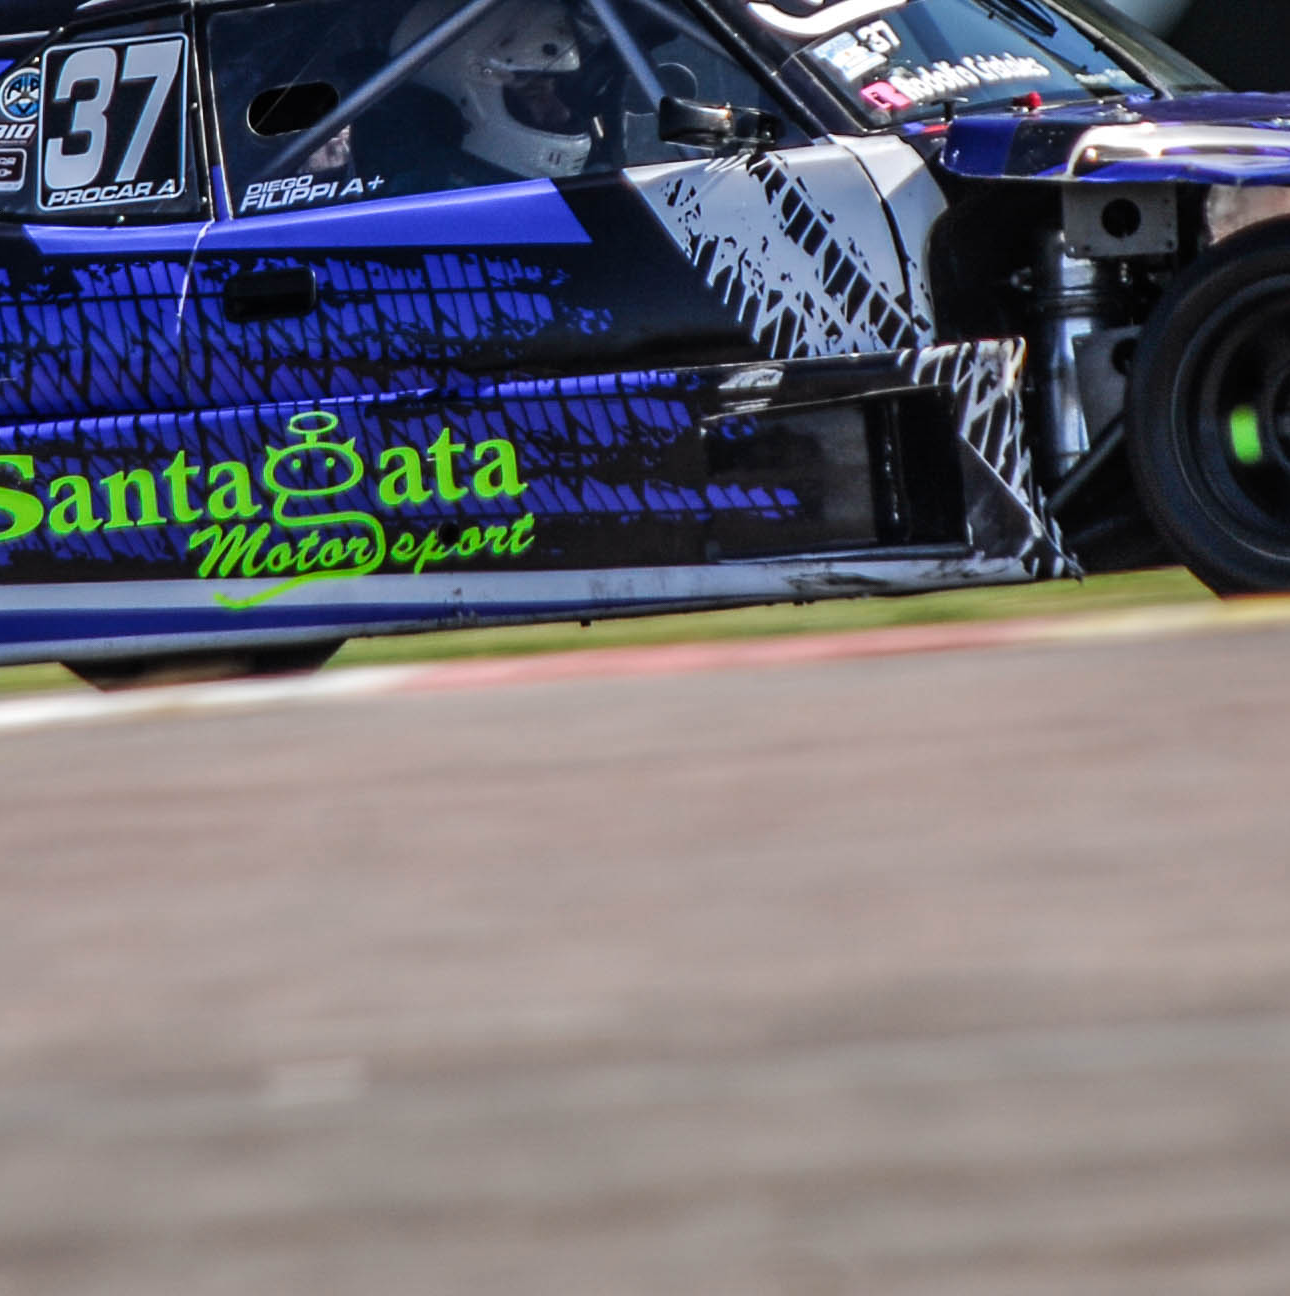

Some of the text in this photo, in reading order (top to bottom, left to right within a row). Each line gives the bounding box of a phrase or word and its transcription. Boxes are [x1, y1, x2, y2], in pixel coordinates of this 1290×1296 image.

[855, 19, 902, 53] 37
[45, 40, 183, 189] 37
[47, 178, 176, 207] PROCAR A
[239, 181, 339, 212] FILIPPI
[246, 174, 314, 196] DIEGO
